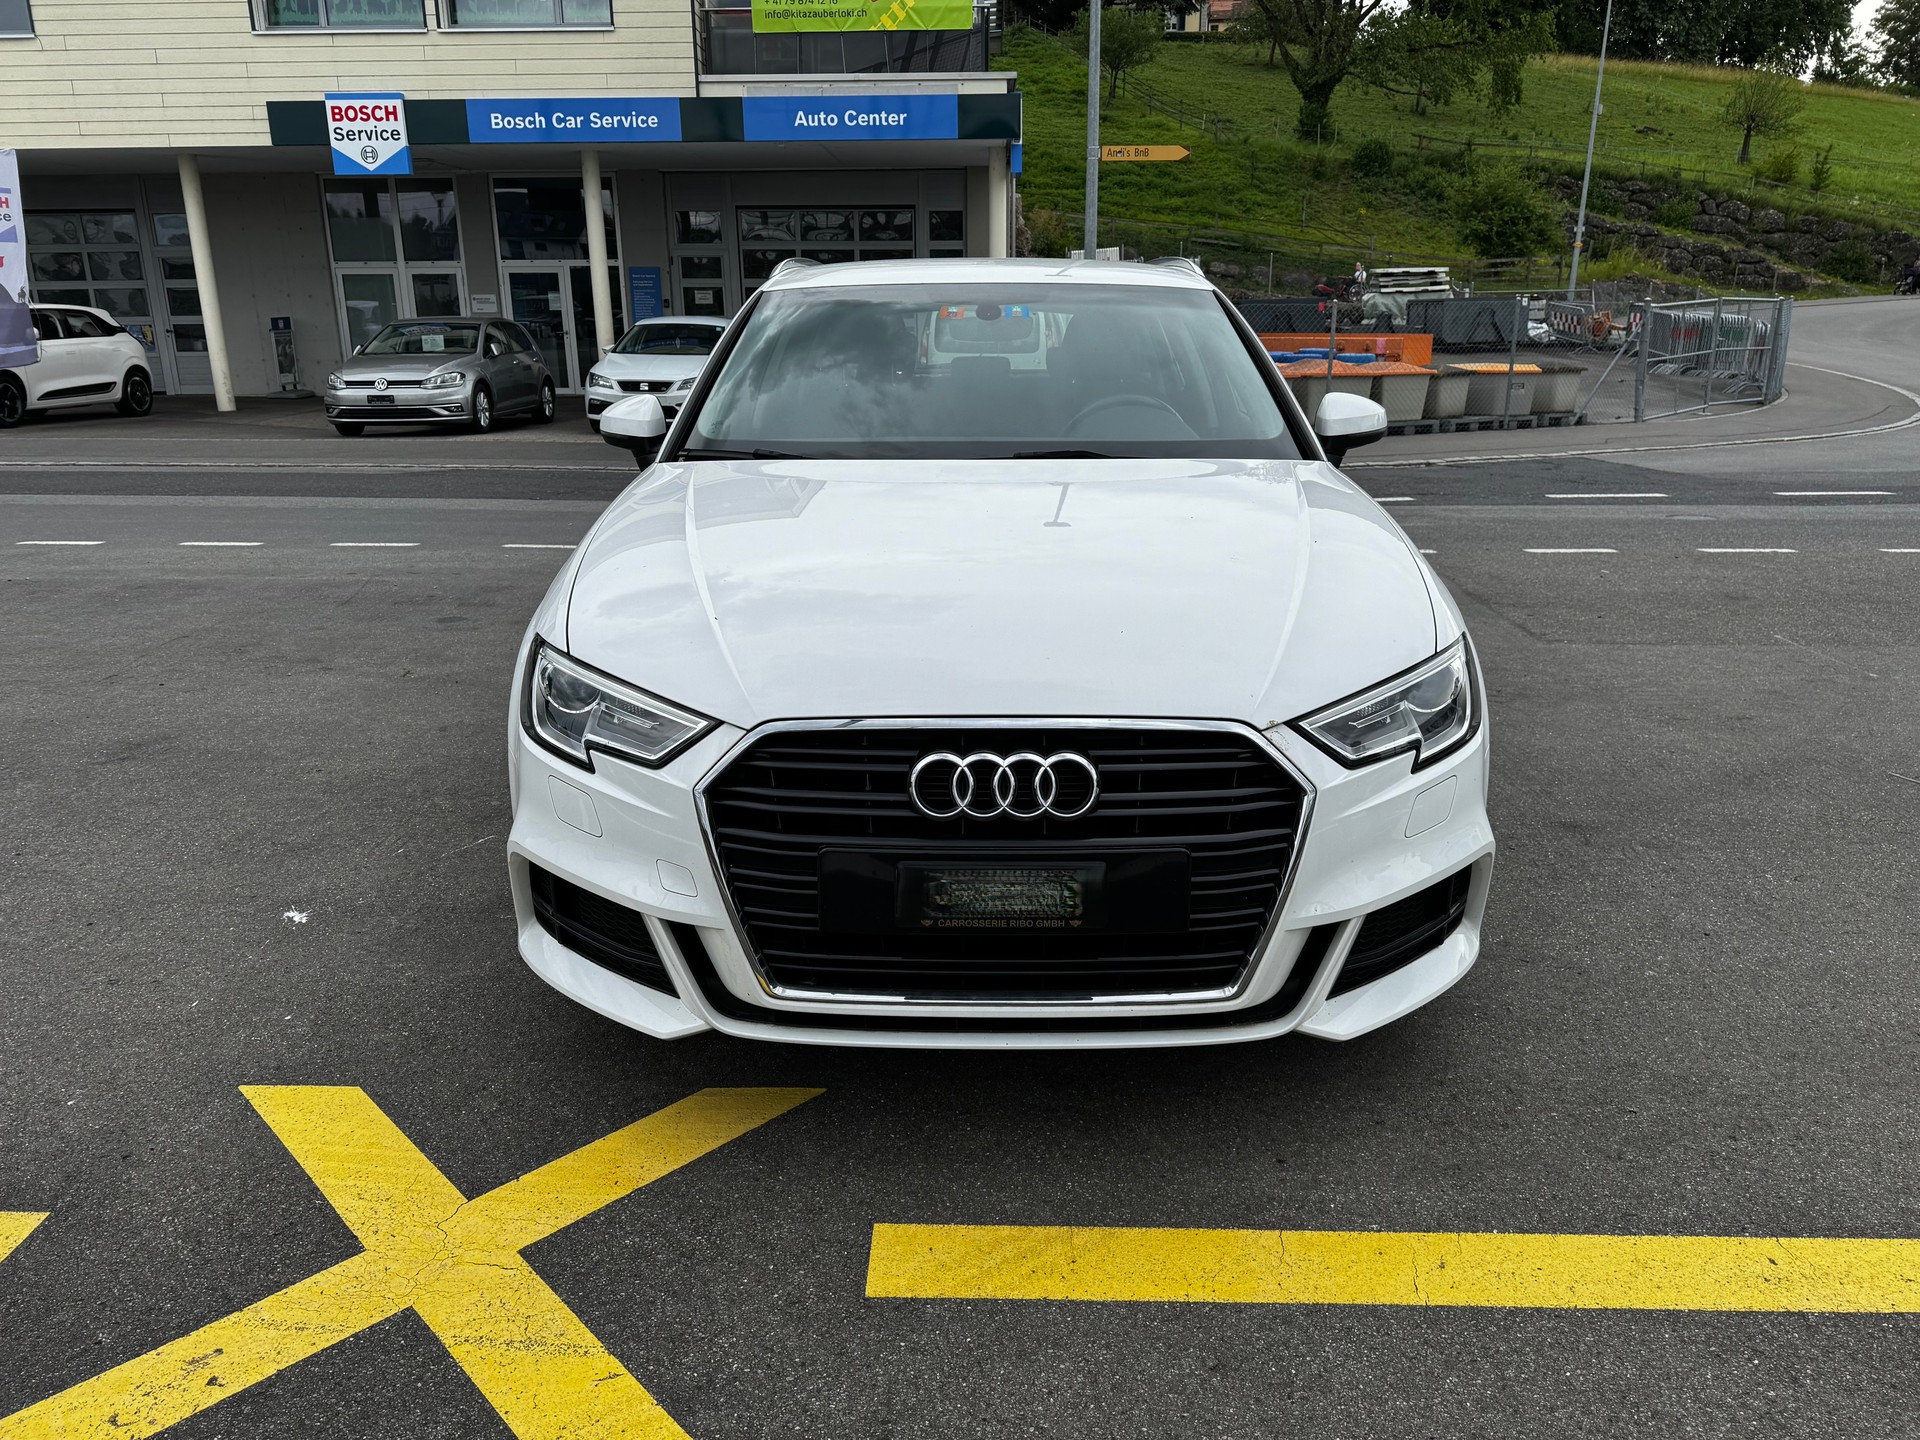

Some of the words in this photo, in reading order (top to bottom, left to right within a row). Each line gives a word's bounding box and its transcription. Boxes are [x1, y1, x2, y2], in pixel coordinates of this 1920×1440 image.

[764, 8, 867, 19] info@kitazauberloki.ch
[330, 105, 399, 122] BOSCH
[490, 112, 546, 129] Bosch
[551, 112, 584, 129] Car
[589, 111, 659, 128] Service
[794, 110, 839, 127] Auto
[844, 109, 907, 126] Center
[333, 125, 401, 142] Service
[1134, 147, 1150, 157] BnB
[937, 919, 1007, 928] CARROSSERIE
[1009, 919, 1034, 928] RIBO
[1036, 919, 1065, 928] GMBH
